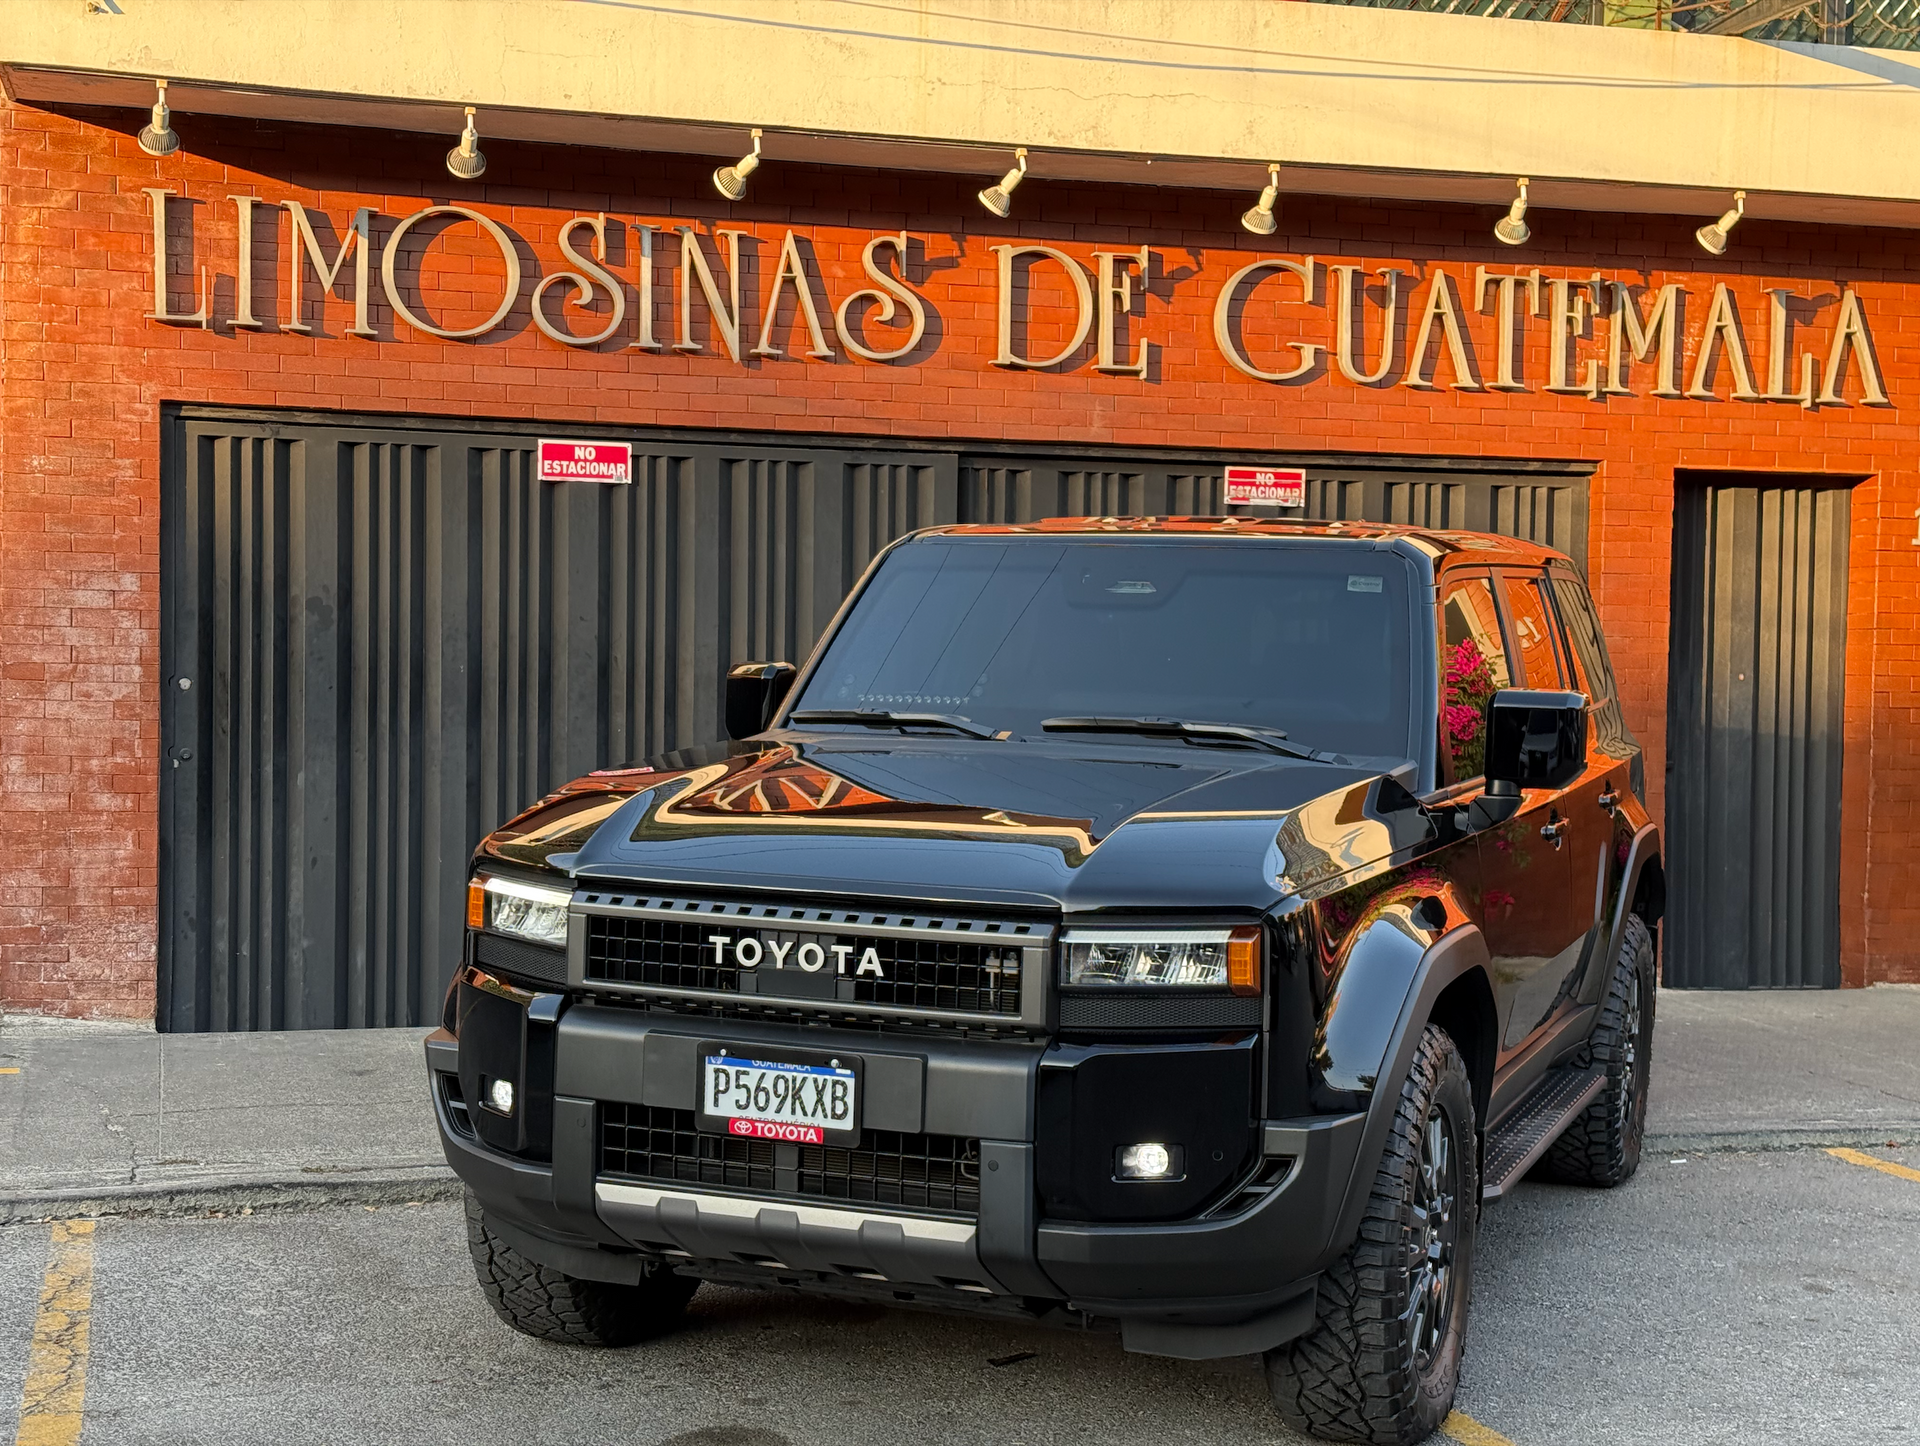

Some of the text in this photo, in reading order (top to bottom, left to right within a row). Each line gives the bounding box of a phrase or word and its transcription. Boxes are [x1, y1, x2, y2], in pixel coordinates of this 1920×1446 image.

[141, 188, 1890, 409] LIMOSINAS DE GUATEMALA
[574, 446, 596, 460] NO
[543, 460, 626, 476] ESTACIONAR
[1255, 472, 1275, 486] NO
[1229, 485, 1301, 500] ESTACIONAR
[708, 935, 884, 977] TOYOTA
[713, 1067, 849, 1121] P569KXB
[755, 1122, 818, 1142] TOYOTA
